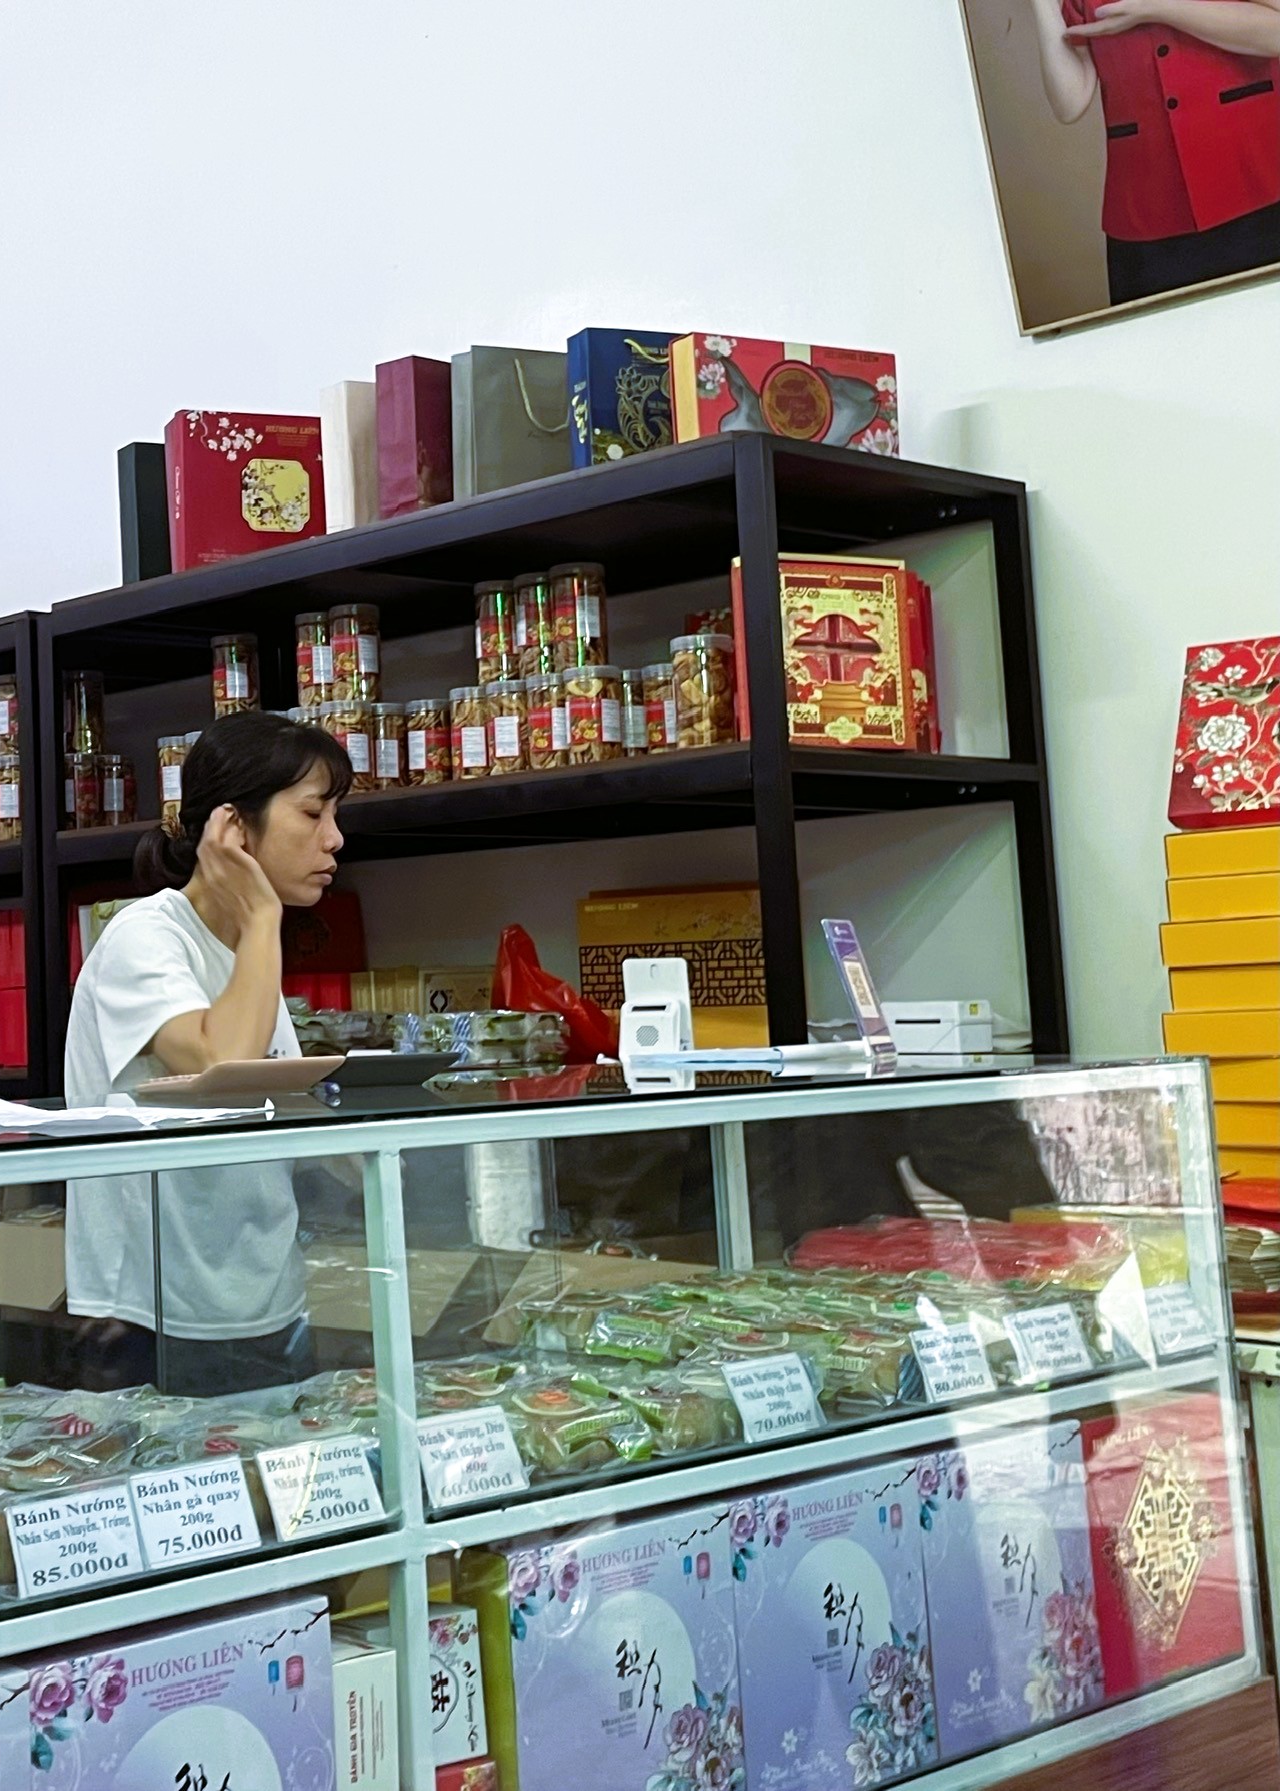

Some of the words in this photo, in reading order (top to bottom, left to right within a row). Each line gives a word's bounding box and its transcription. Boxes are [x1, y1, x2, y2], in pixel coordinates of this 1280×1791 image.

[265, 1455, 305, 1473] Bánh
[136, 1479, 179, 1498] Bánh
[184, 1469, 241, 1490] Nướng
[13, 1508, 60, 1527] Bánh
[66, 1497, 127, 1518] Nướng
[142, 1499, 182, 1516] Nhân
[186, 1492, 202, 1509] gà
[206, 1489, 240, 1506] quay
[180, 1511, 214, 1527] 200g
[16, 1531, 42, 1546] Nhân
[58, 1541, 98, 1558] 200g
[131, 1655, 198, 1688] HƯƠNG
[201, 1641, 245, 1669] LIÊN
